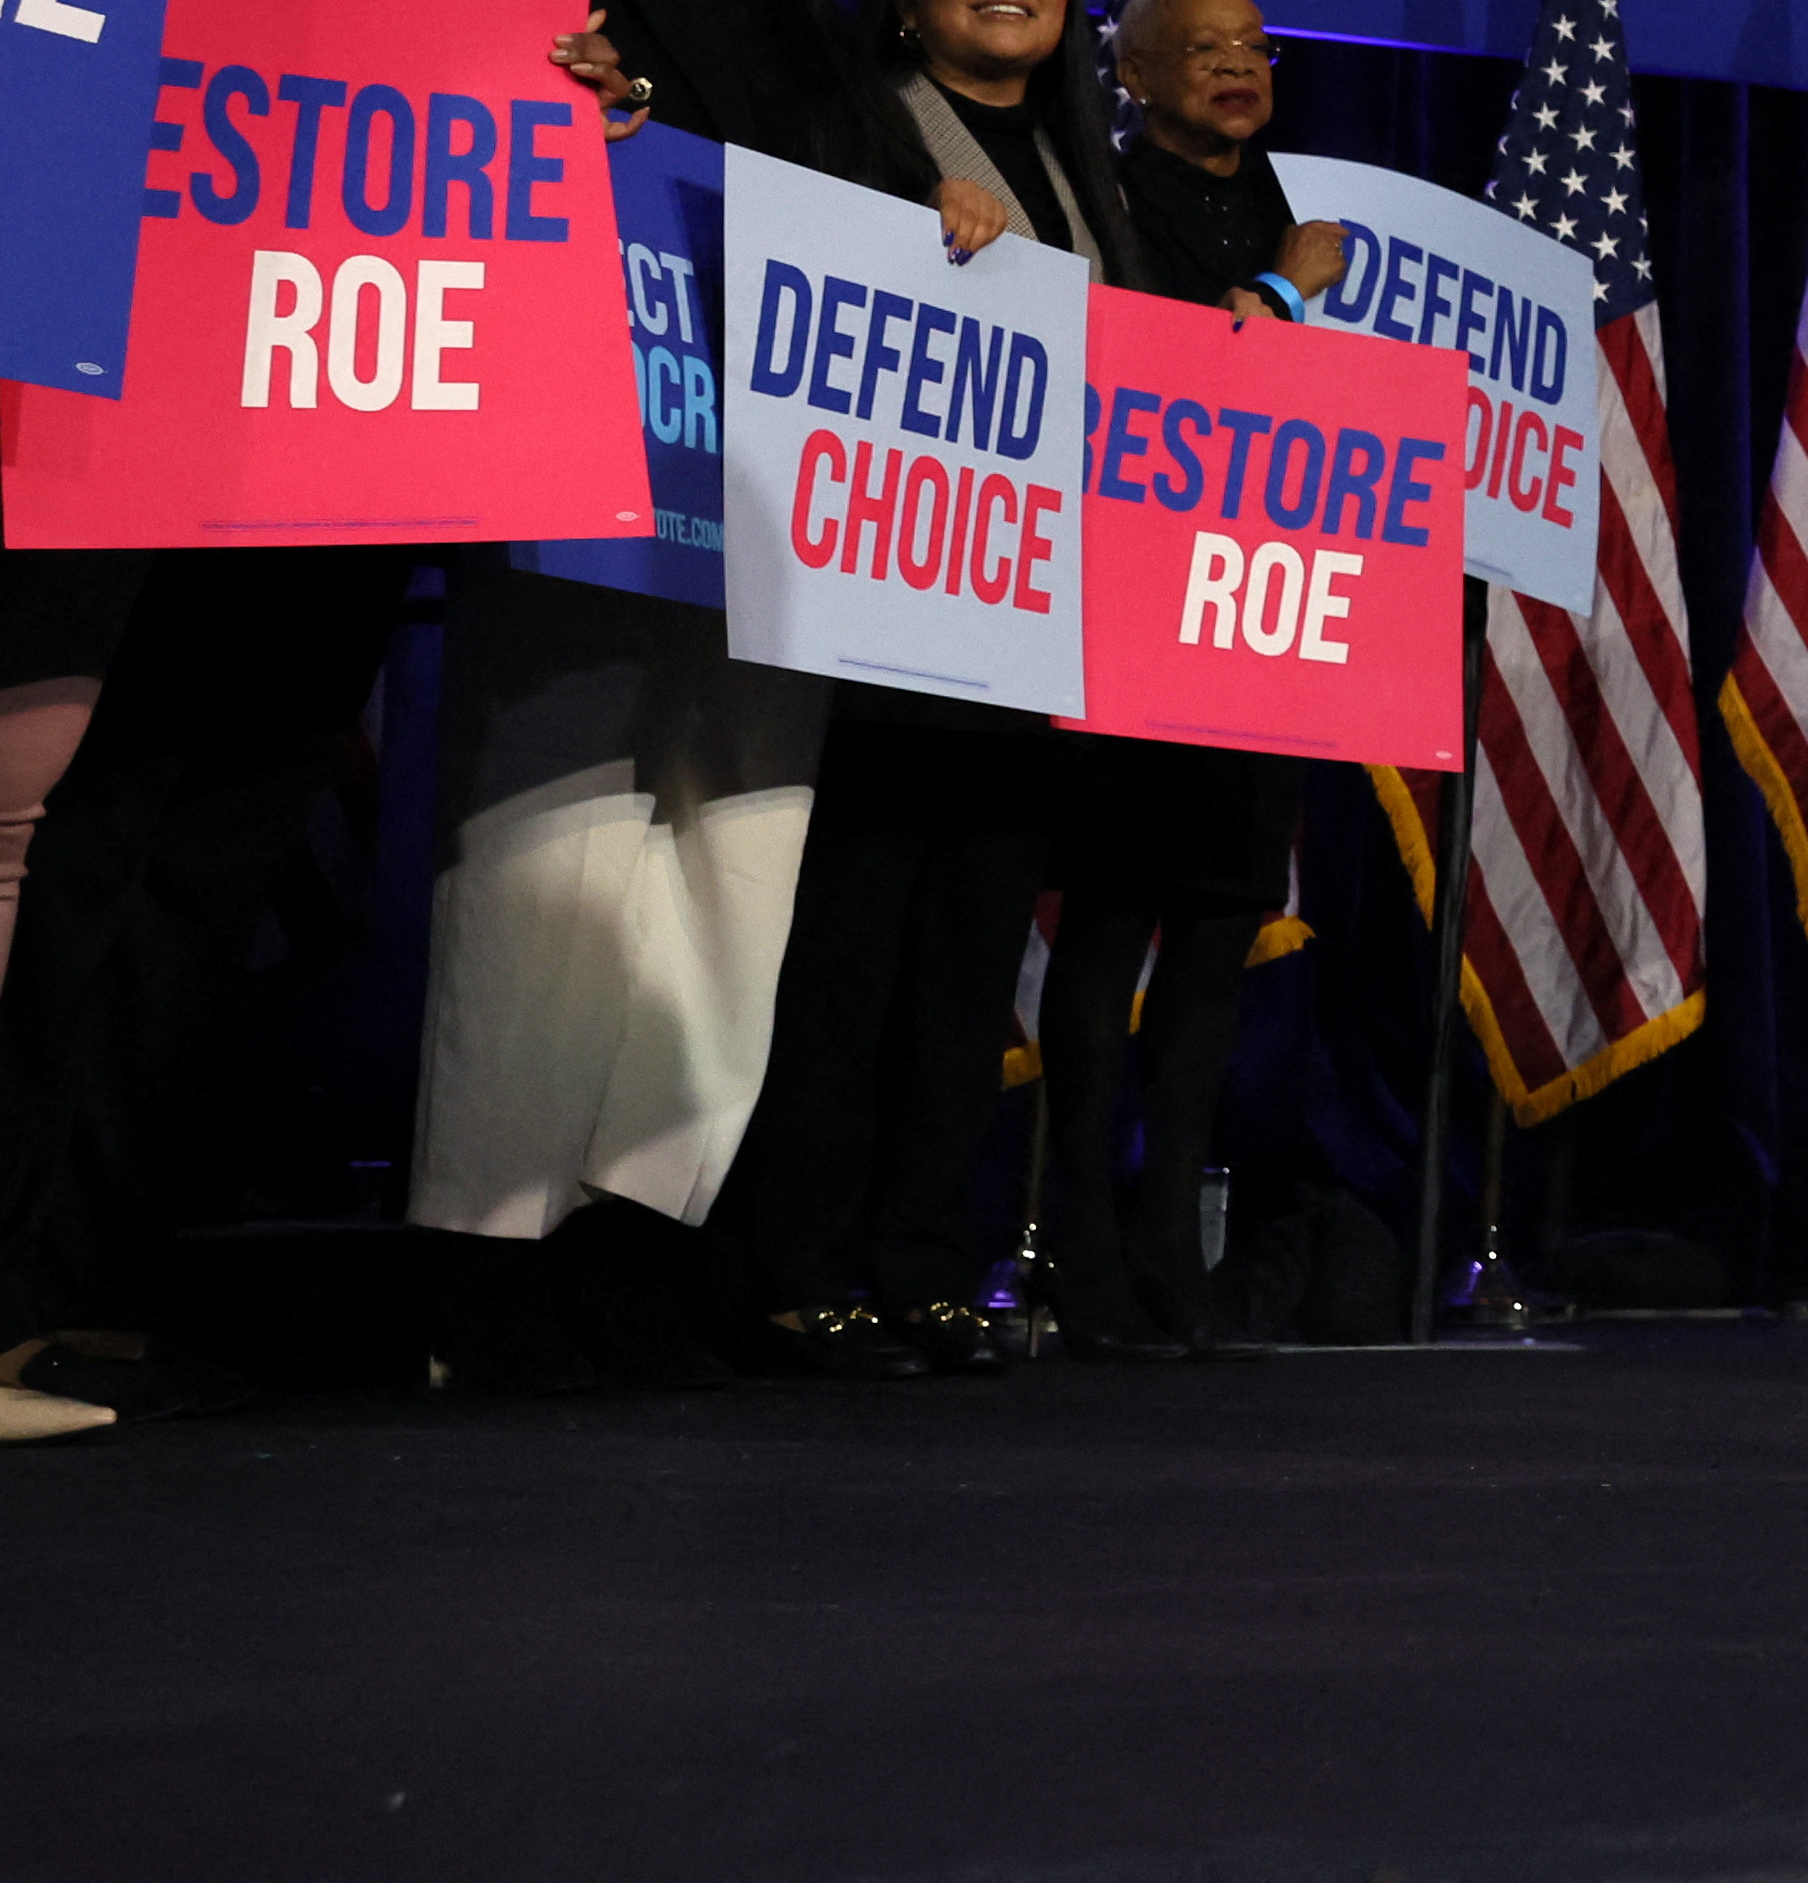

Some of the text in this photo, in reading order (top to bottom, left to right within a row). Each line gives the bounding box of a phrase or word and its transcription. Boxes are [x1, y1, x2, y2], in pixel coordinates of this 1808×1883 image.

[240, 249, 486, 412] ROE
[617, 237, 695, 344] CT
[750, 258, 1049, 461] DEFEND
[1322, 218, 1568, 406] DEFEND
[790, 428, 1063, 615] CHOICE
[1178, 530, 1365, 664] ROE
